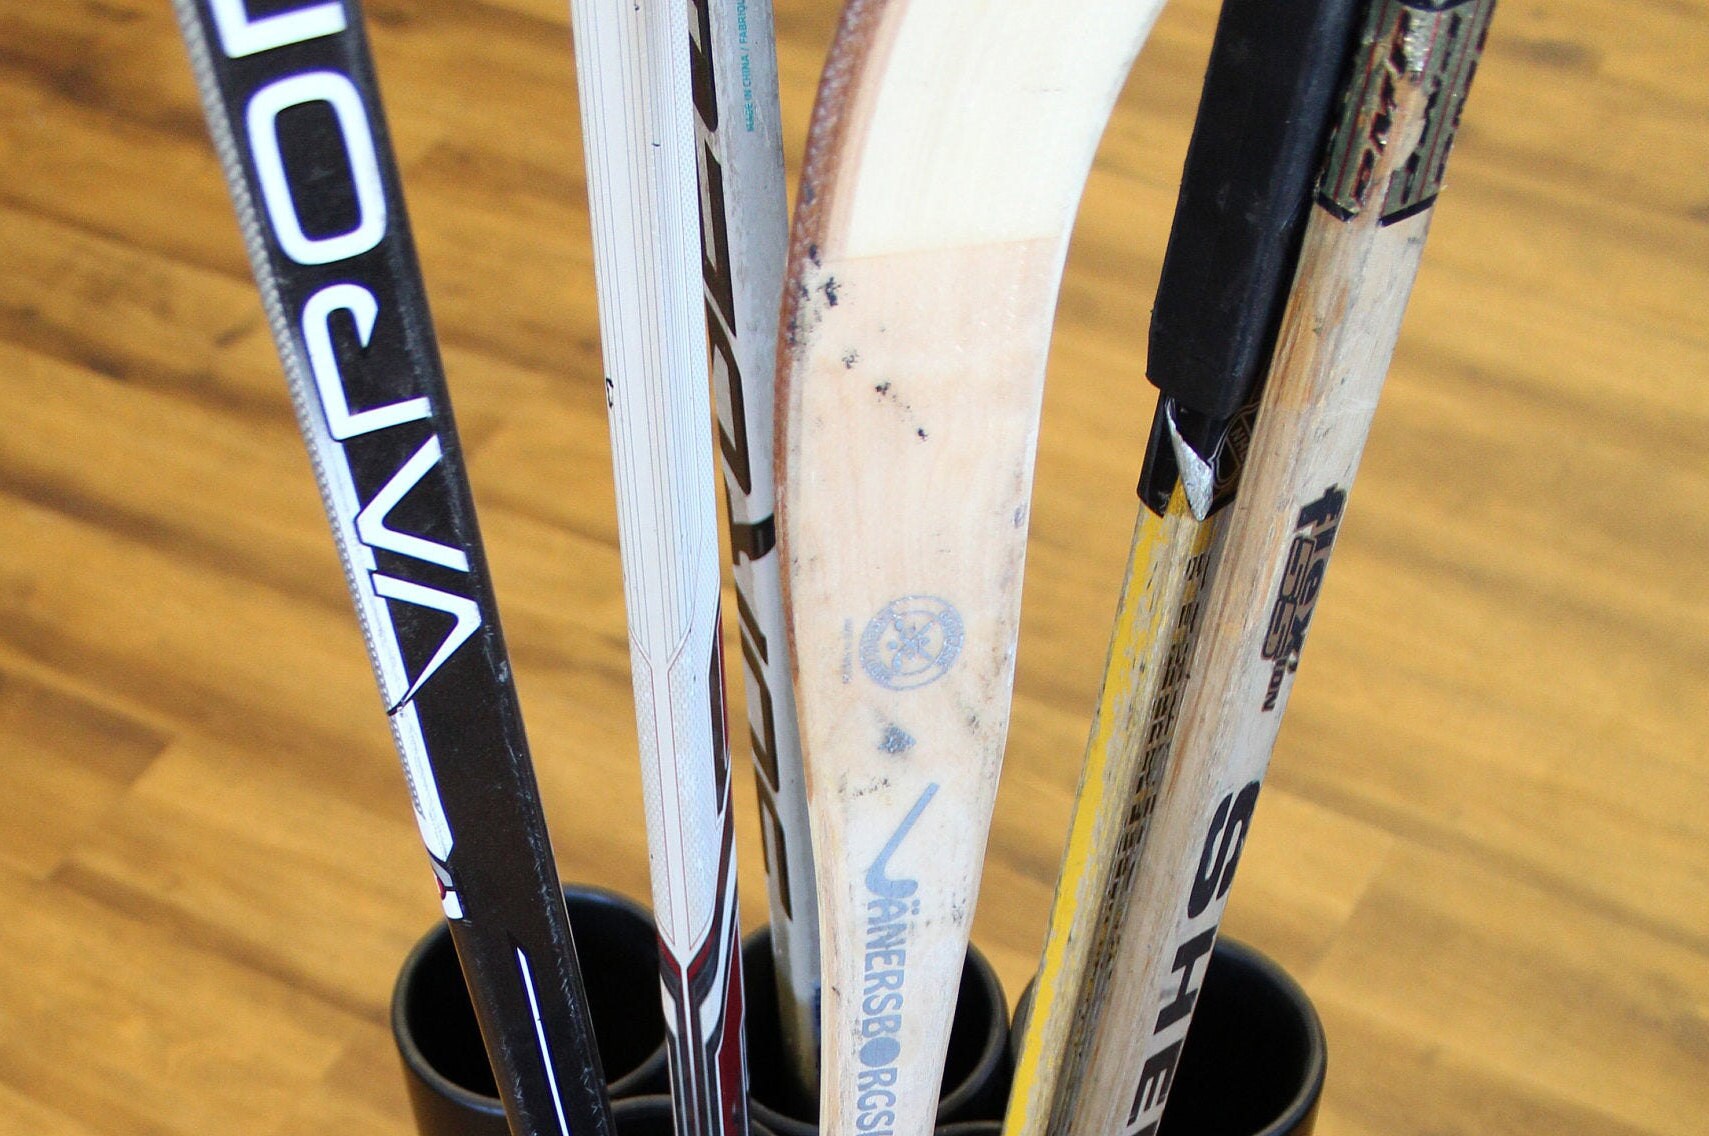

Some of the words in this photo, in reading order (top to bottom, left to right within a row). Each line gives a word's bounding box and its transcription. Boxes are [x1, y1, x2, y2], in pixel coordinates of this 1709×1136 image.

[741, 54, 751, 88] CHINA
[744, 90, 752, 101] IN
[745, 103, 755, 132] MADE
